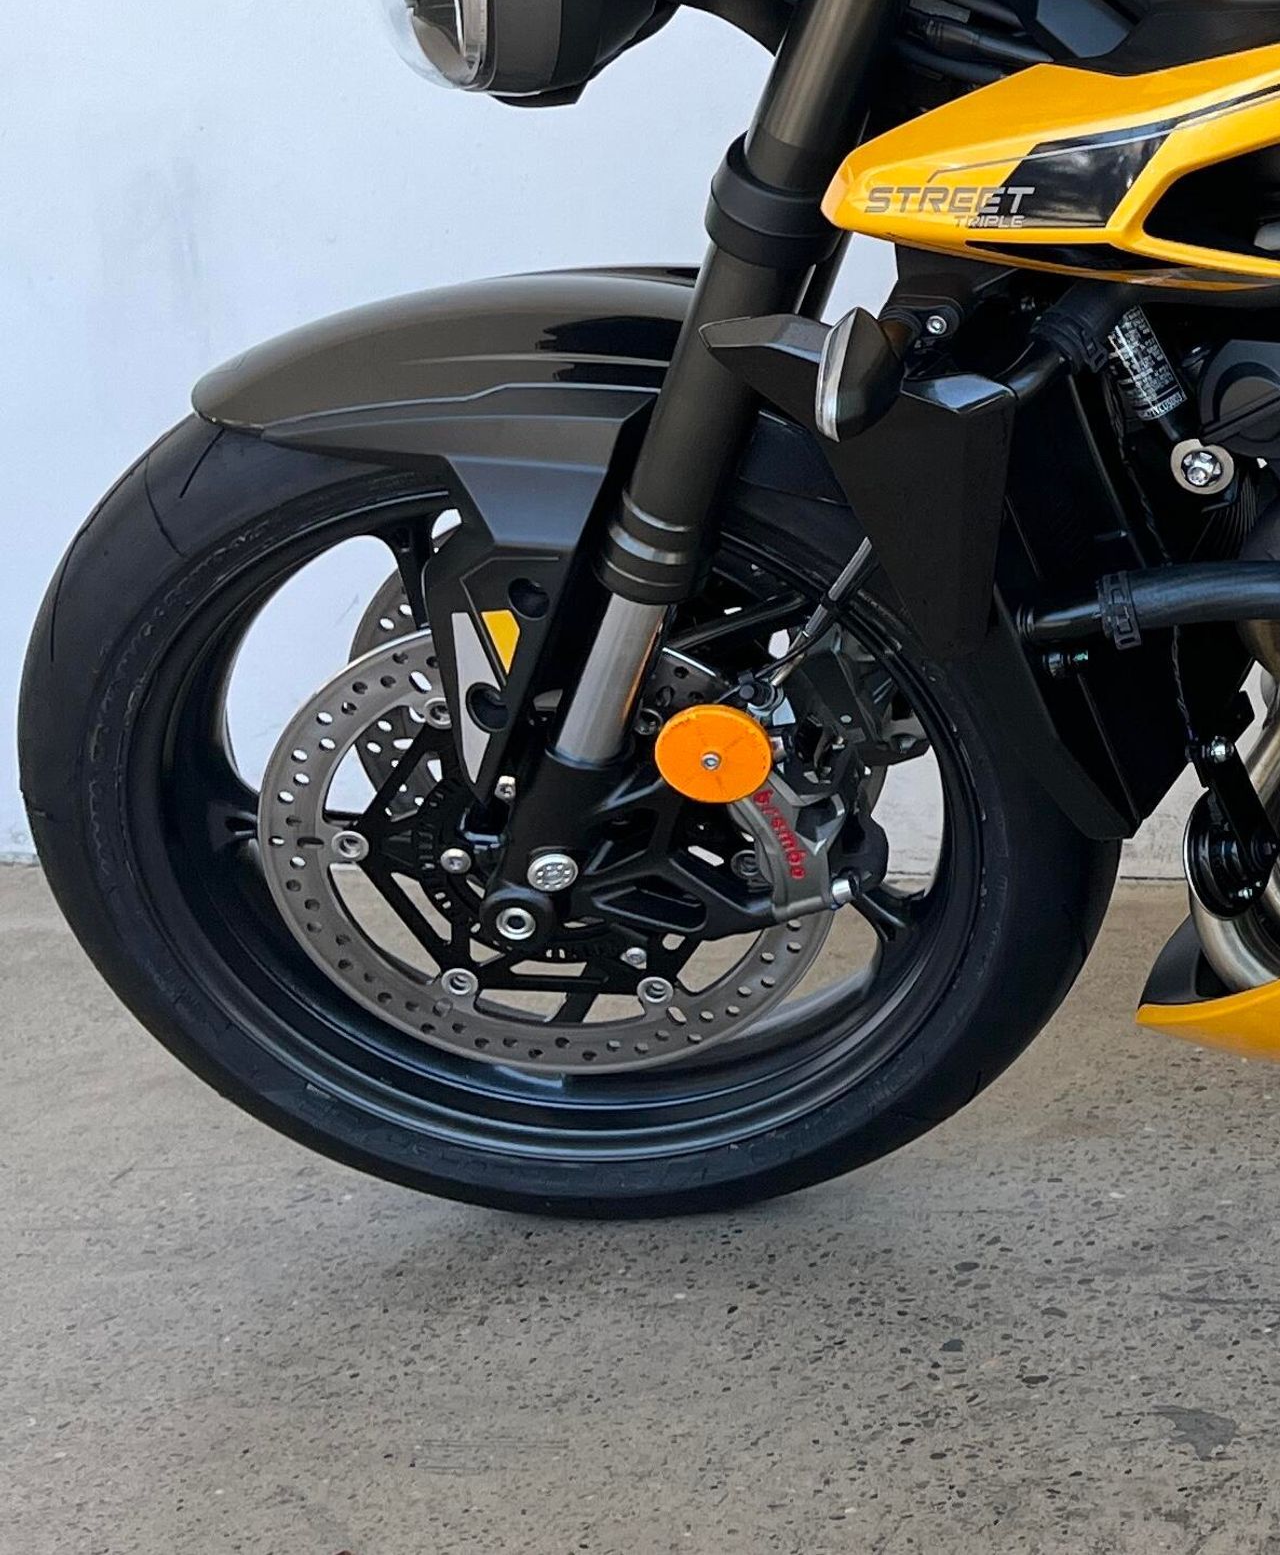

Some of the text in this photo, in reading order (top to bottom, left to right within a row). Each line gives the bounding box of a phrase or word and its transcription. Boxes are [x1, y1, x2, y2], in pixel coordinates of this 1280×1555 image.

[864, 186, 1036, 214] STREET
[953, 215, 1026, 229] TRIPLE
[752, 788, 807, 879] brembo
